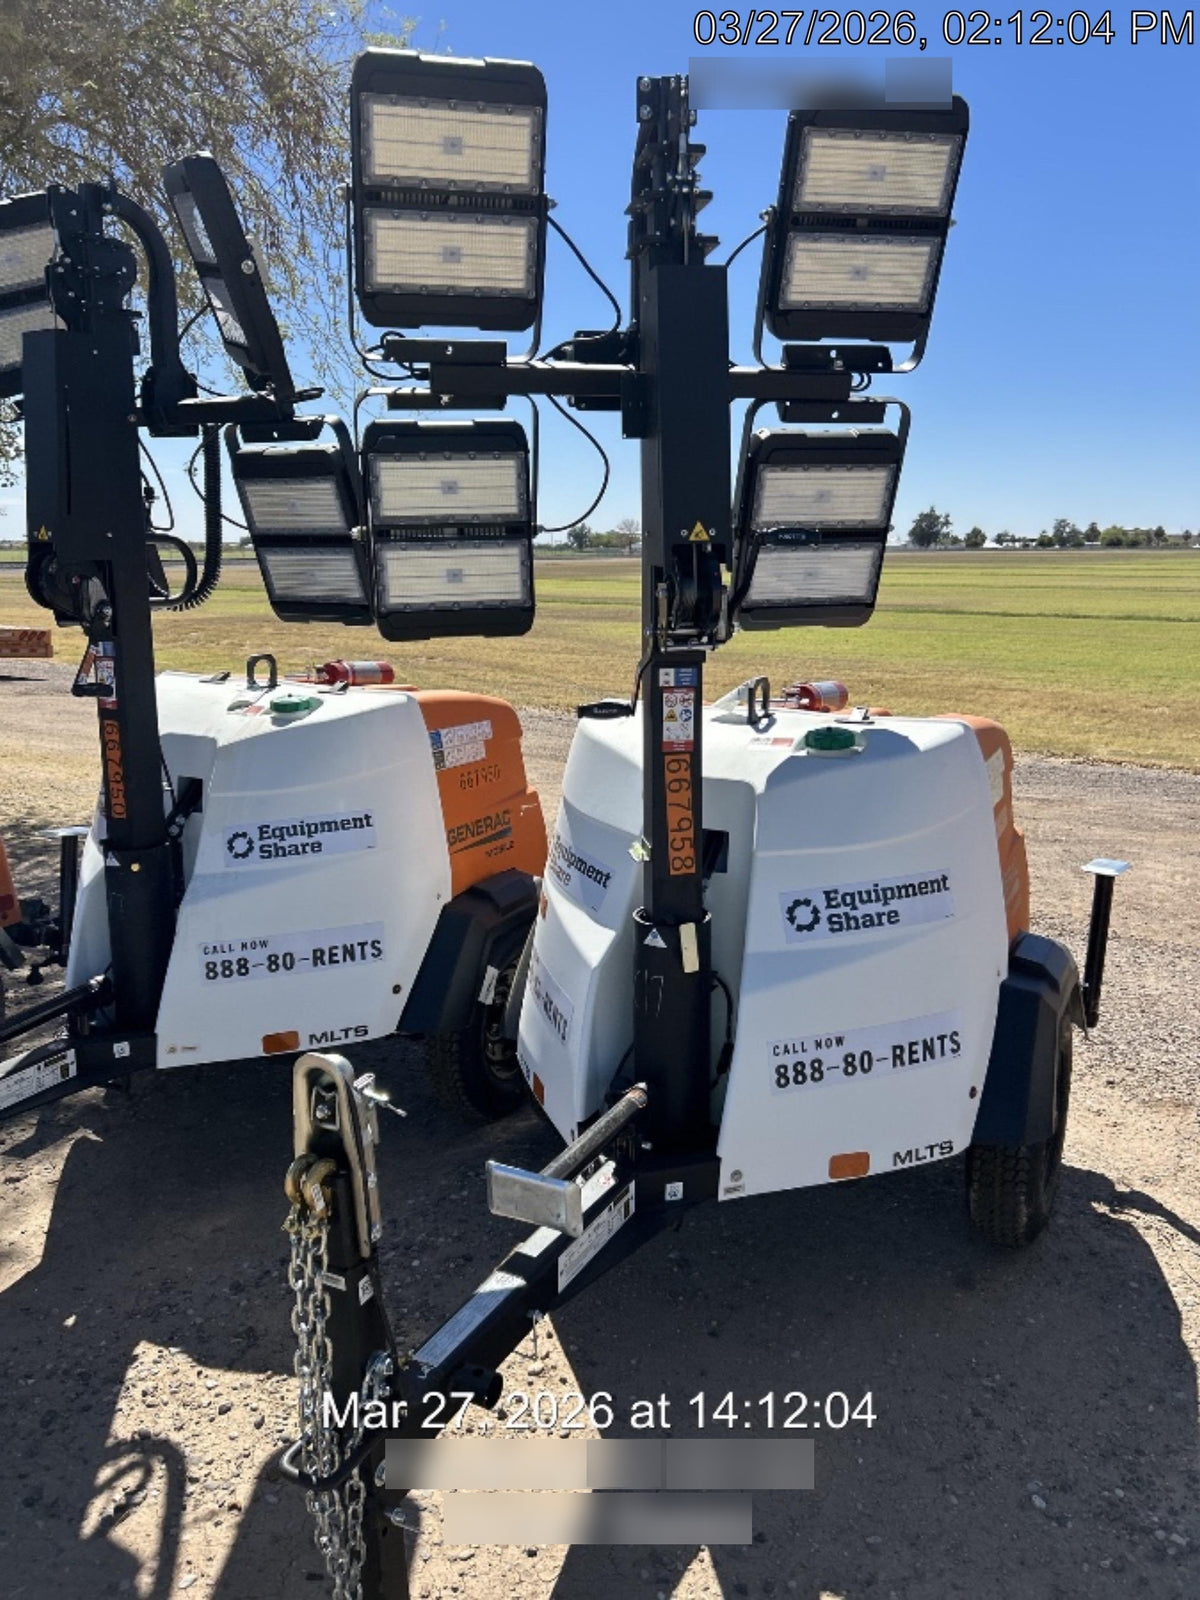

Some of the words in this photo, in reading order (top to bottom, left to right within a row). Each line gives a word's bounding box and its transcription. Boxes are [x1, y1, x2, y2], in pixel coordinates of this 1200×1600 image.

[257, 814, 373, 841] Equipment
[447, 810, 511, 846] GENERAC
[666, 757, 695, 872] 667958
[259, 841, 323, 859] Share
[823, 874, 950, 910] Equipment
[827, 909, 900, 933] Share
[203, 942, 235, 956] CALL
[241, 939, 269, 952] NOW
[205, 940, 383, 980] 888-80-RENTS
[308, 1025, 369, 1045] MLTS
[773, 1040, 808, 1057] CALL
[815, 1036, 845, 1050] NOW
[775, 1031, 961, 1089] 888-80-RENTS
[893, 1140, 954, 1167] MLTS
